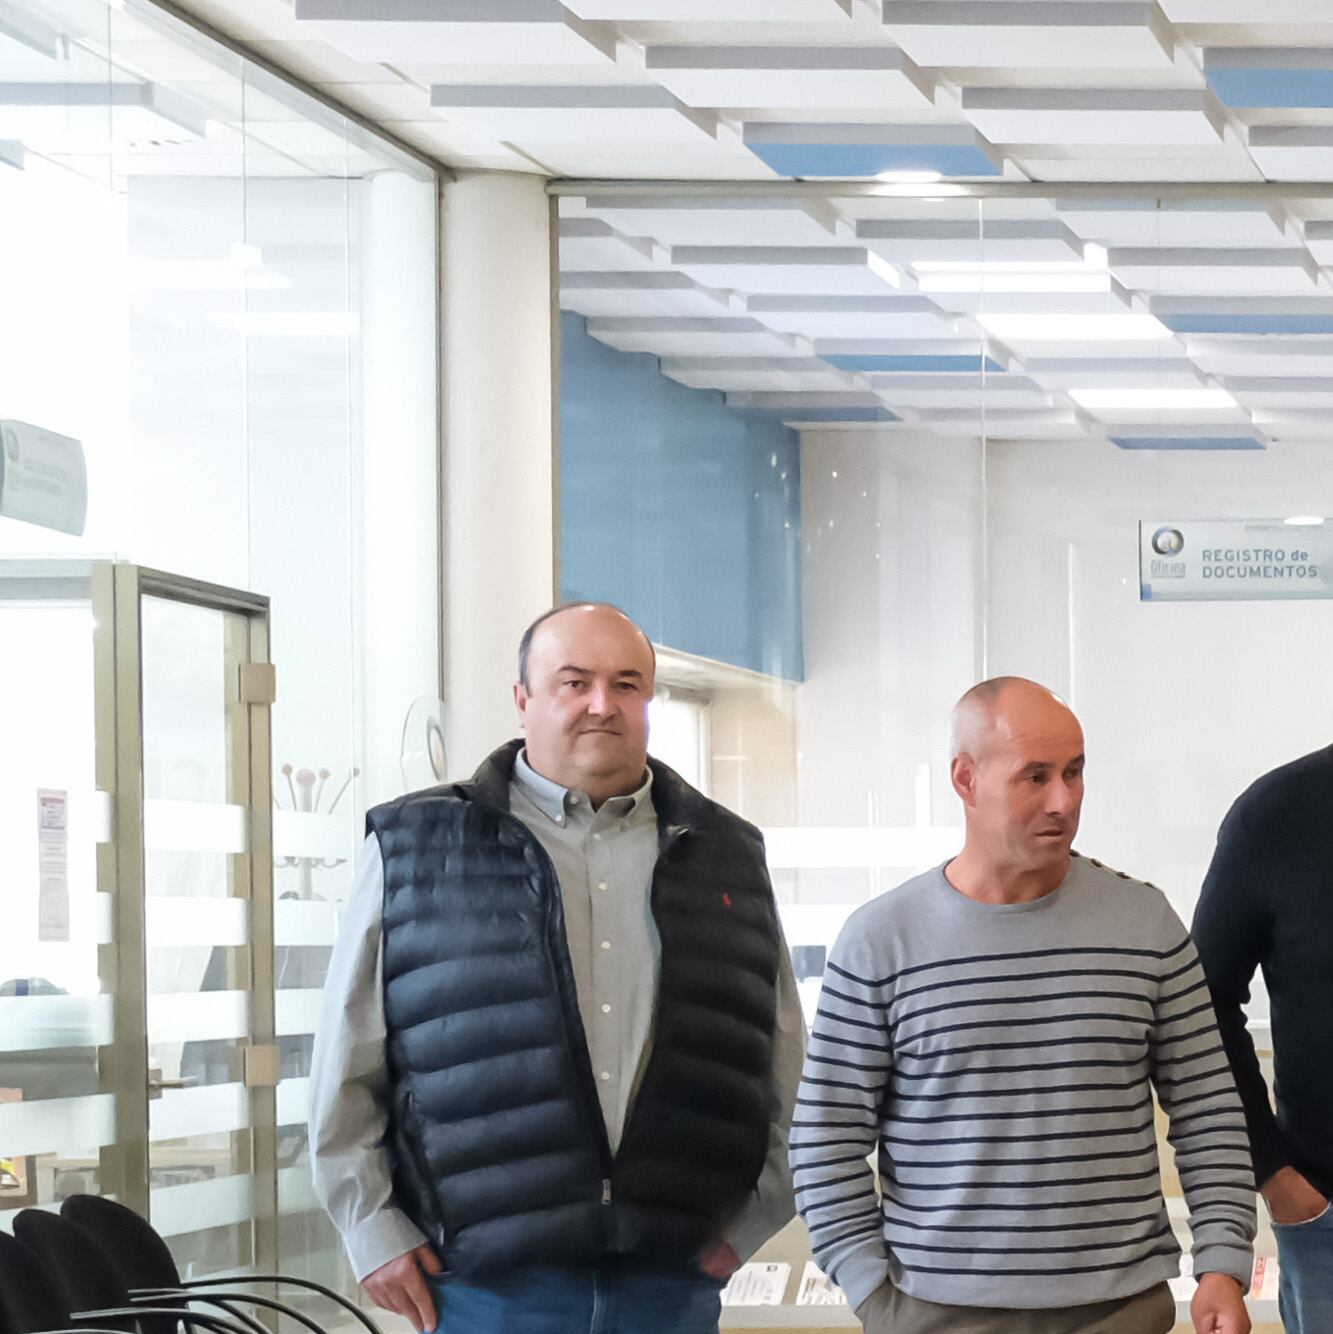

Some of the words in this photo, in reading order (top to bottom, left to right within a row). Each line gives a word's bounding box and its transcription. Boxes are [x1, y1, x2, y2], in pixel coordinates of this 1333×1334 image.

[1202, 550, 1286, 562] REGISTRO
[1291, 551, 1309, 561] de
[1202, 565, 1318, 578] DOCUMENTOS
